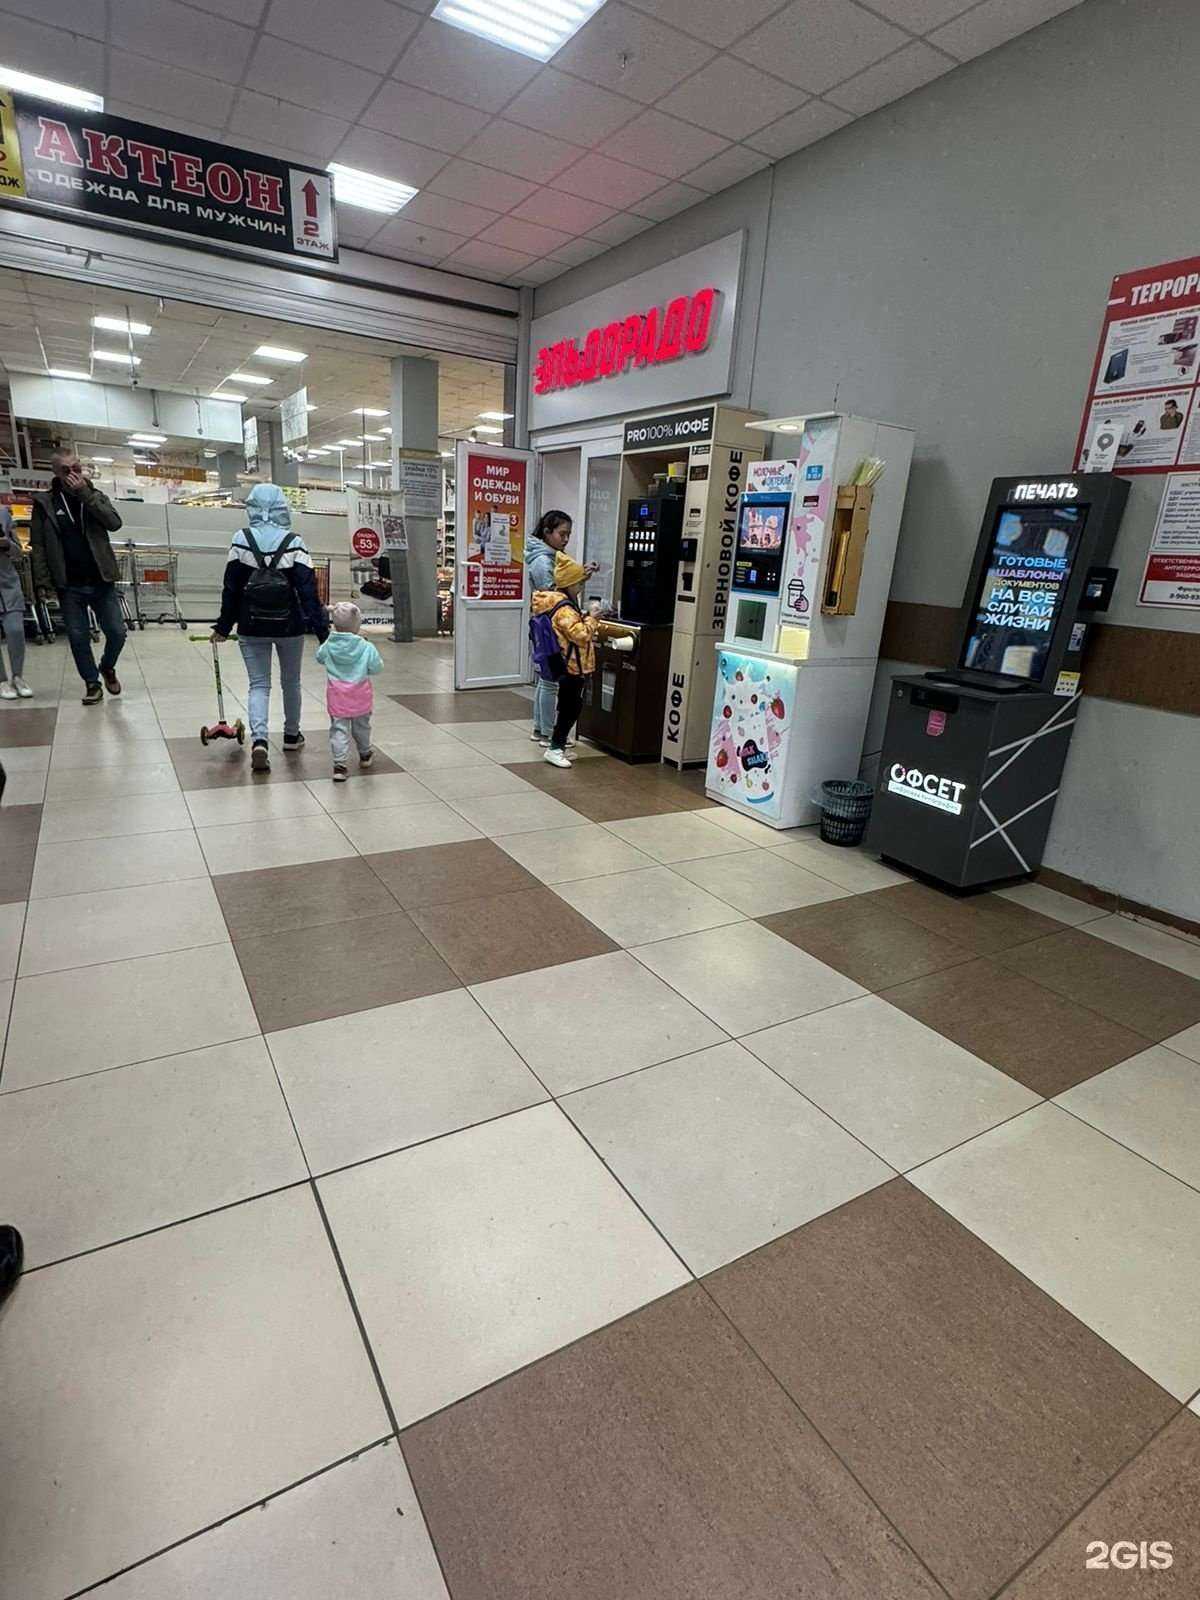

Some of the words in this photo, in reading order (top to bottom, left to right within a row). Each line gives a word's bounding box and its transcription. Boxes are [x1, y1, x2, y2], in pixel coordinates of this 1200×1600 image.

[34, 117, 285, 215] АКТЕОН
[37, 169, 139, 204] ОДЕЖДА
[147, 195, 190, 215] ДЛЯ
[197, 206, 286, 236] МУЖЧИН
[303, 220, 320, 238] 2
[296, 236, 329, 251] ЭТАЖ
[1131, 273, 1200, 306] ТЕРРОР
[674, 418, 710, 436] КОФЕ
[486, 464, 510, 477] МИР
[473, 477, 520, 492] ОДЕЖДЫ
[1014, 482, 1079, 500] ПЕЧАТЬ
[474, 491, 482, 502] И
[485, 492, 519, 504] ОБУВИ
[712, 519, 736, 630] ЗЕРНОВОЙ
[724, 450, 744, 513] КОФЕ
[998, 556, 1068, 570] ГОТОВЫЕ
[994, 568, 1064, 581] ШАБЛОНЫ
[992, 578, 1060, 591] ДОКУМЕНТОВ
[990, 589, 1014, 601] НА
[1018, 590, 1058, 605] ВСЕ
[983, 612, 1050, 632] ЖИЗНИ
[667, 672, 685, 743] КОФЕ
[890, 763, 966, 802] ОФСЕТ
